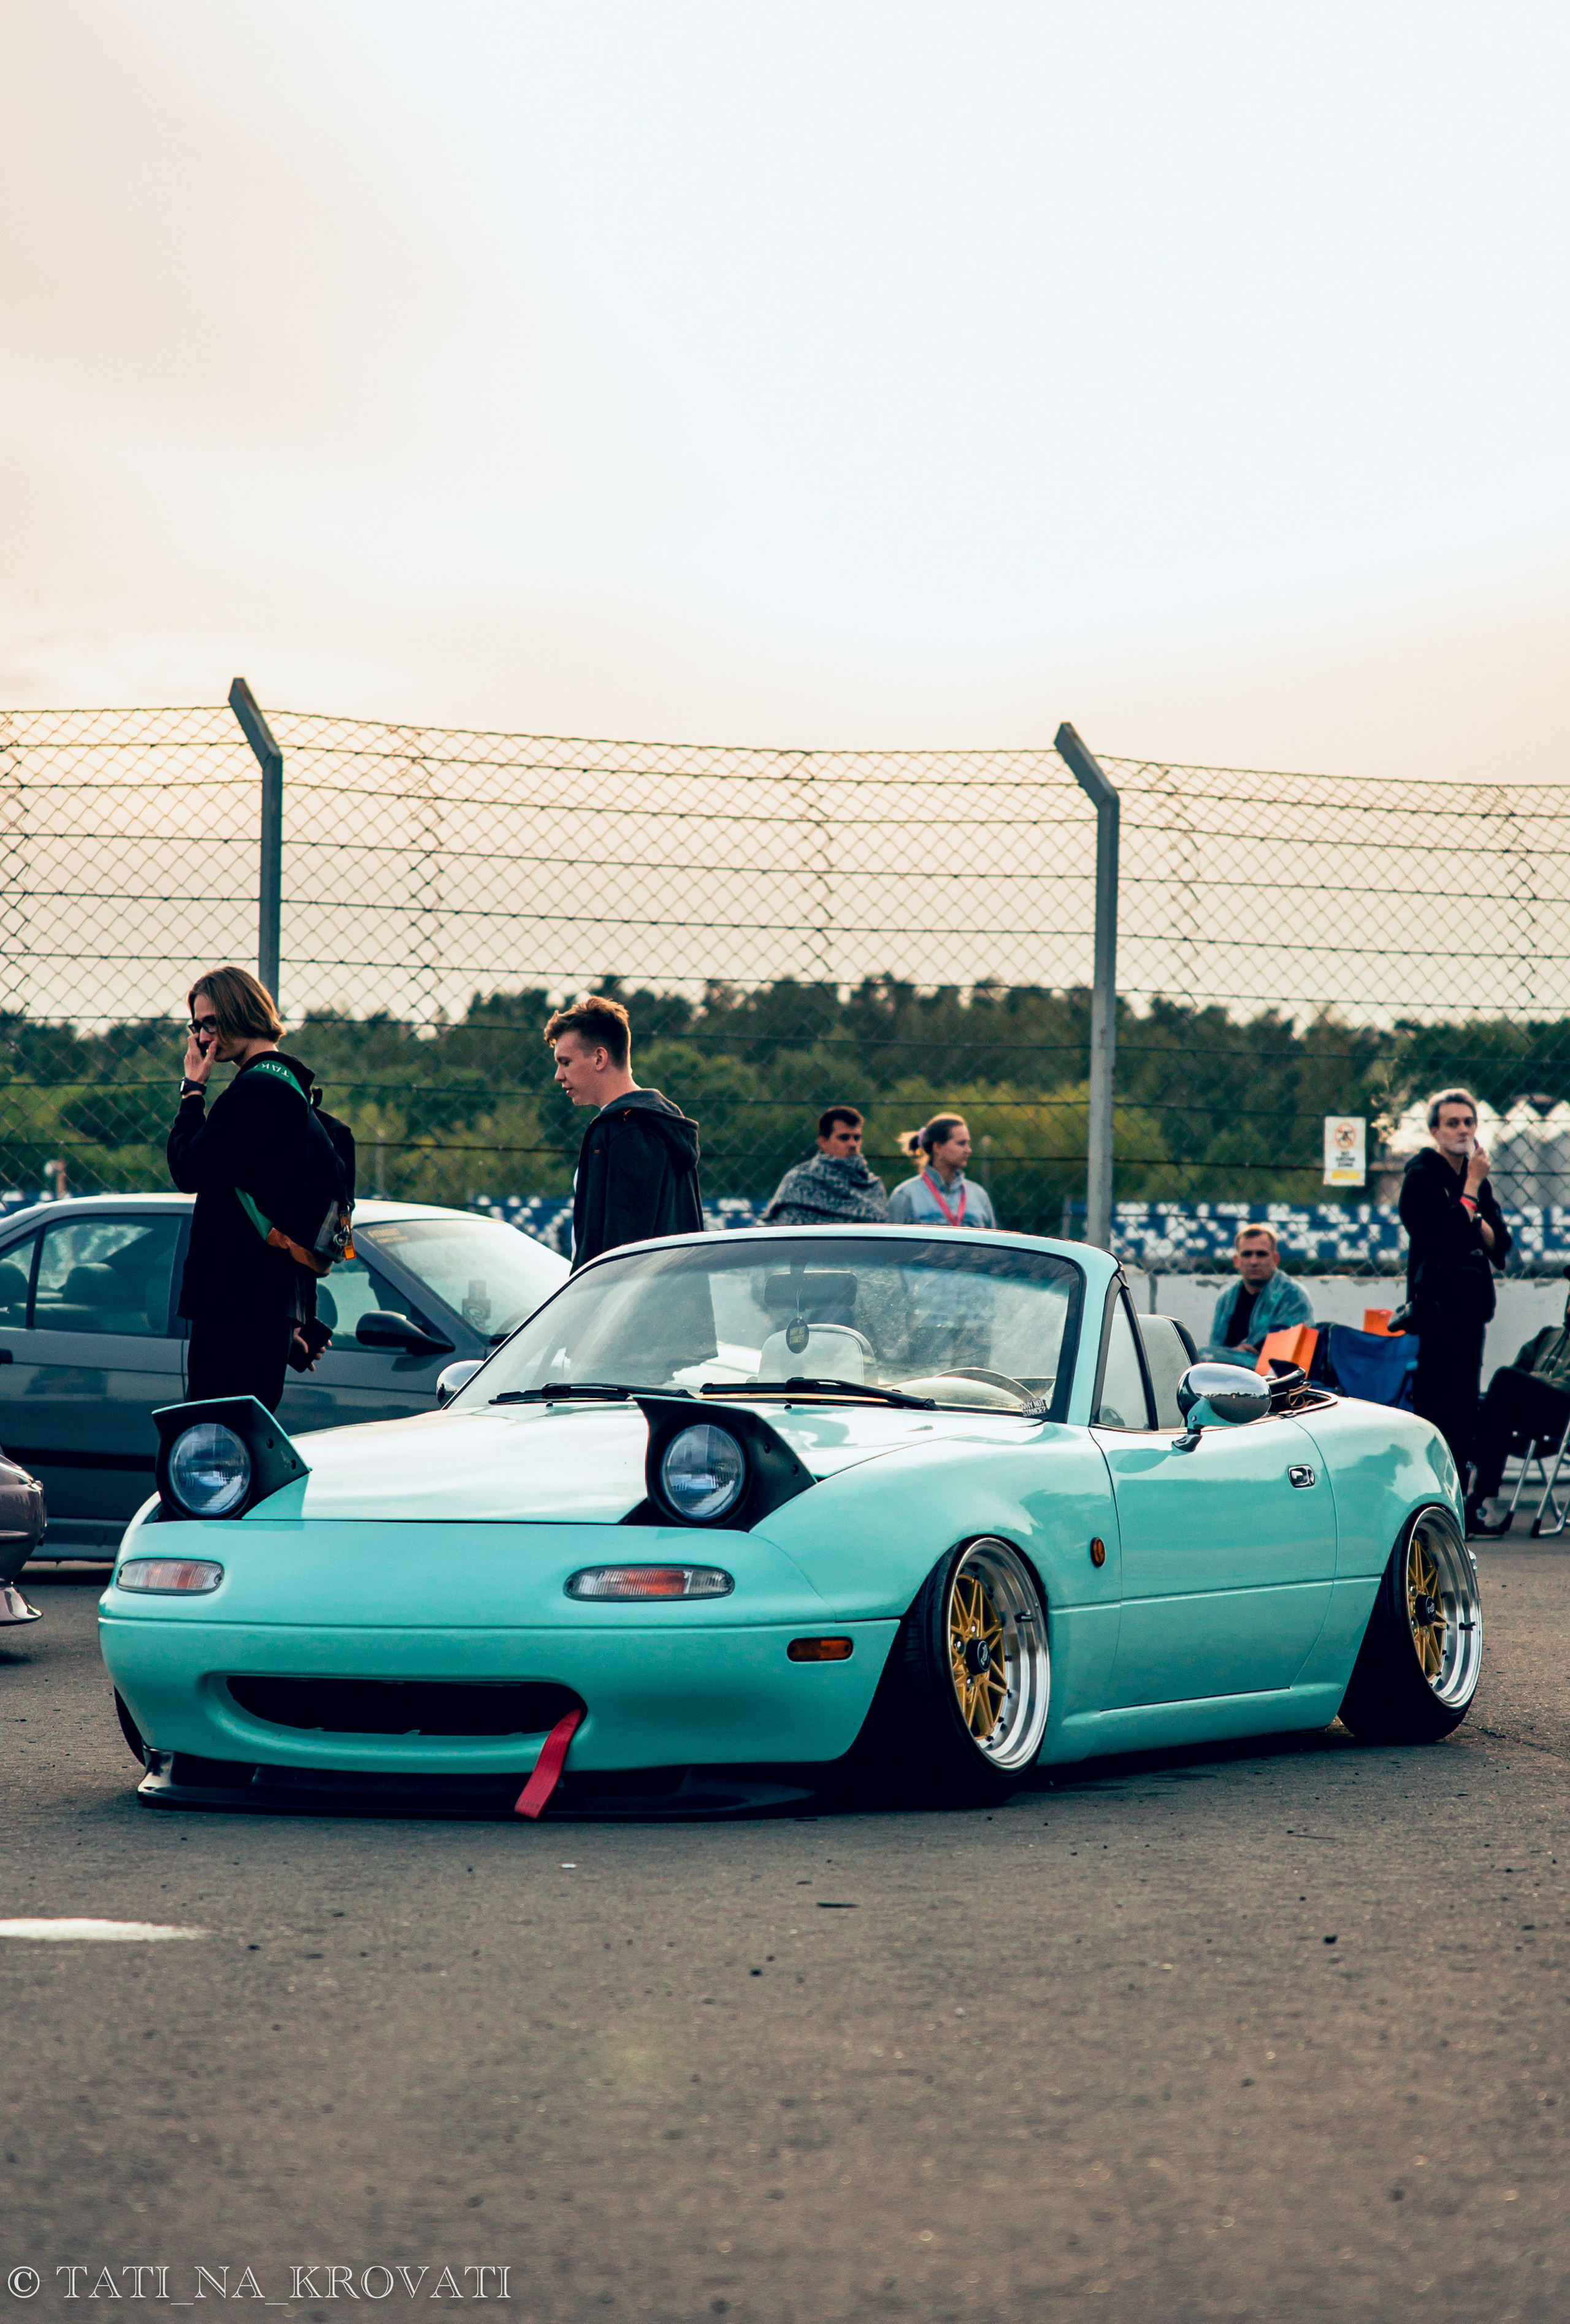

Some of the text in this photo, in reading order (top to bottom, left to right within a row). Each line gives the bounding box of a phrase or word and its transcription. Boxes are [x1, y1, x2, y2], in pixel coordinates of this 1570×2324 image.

[1019, 1399, 1044, 1410] WHY NOT
[1022, 1406, 1046, 1417] STANCE?
